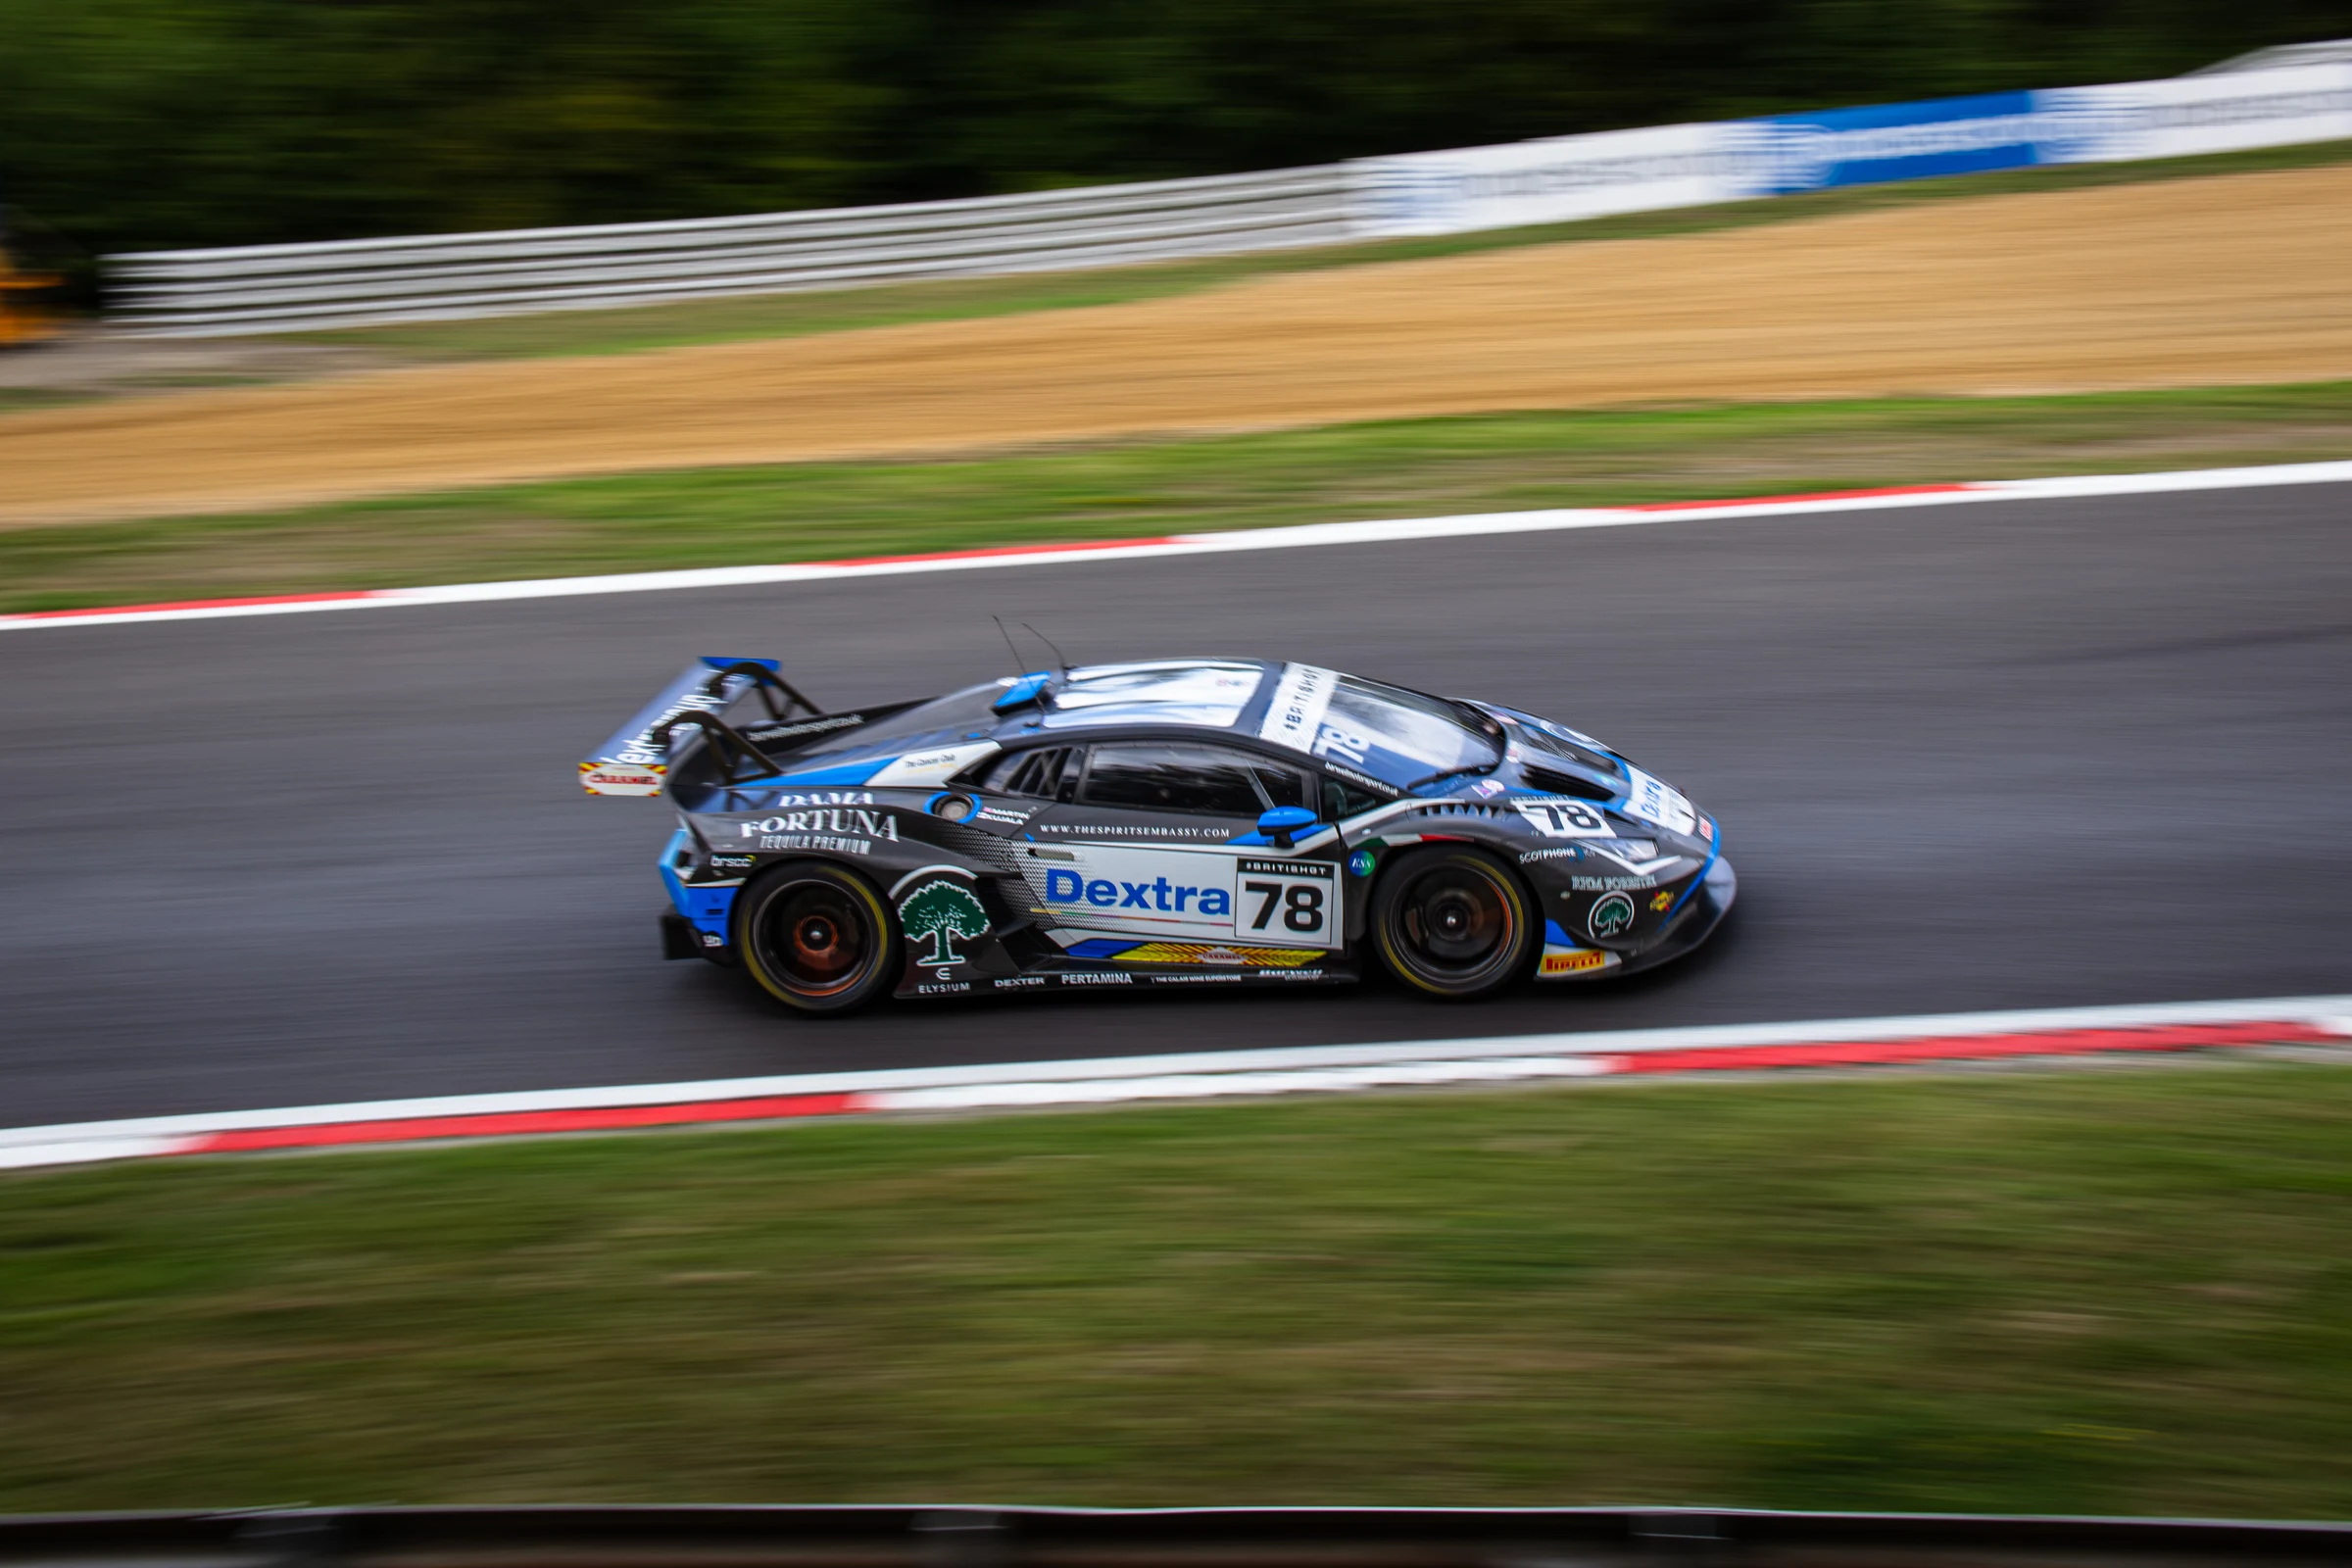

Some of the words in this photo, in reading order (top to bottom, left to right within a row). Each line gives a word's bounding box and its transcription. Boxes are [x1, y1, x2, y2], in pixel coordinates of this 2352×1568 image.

[1311, 722, 1371, 764] 78
[778, 792, 874, 807] DAMA
[741, 808, 899, 843] FORTUNA
[1524, 805, 1602, 832] 78
[1040, 824, 1230, 837] WWW.THESPIRITSEMBASSY.COM
[760, 835, 810, 850] TEQUILA
[811, 836, 872, 855] PREMIUM
[710, 855, 753, 867] brscc
[1246, 861, 1326, 875] #BRITISHGT
[1047, 868, 1230, 915] Dextra
[1245, 880, 1323, 932] 78
[995, 976, 1046, 988] DEXTER
[1061, 973, 1133, 985] PERTAMINA
[918, 982, 970, 994] ELYSIUM
